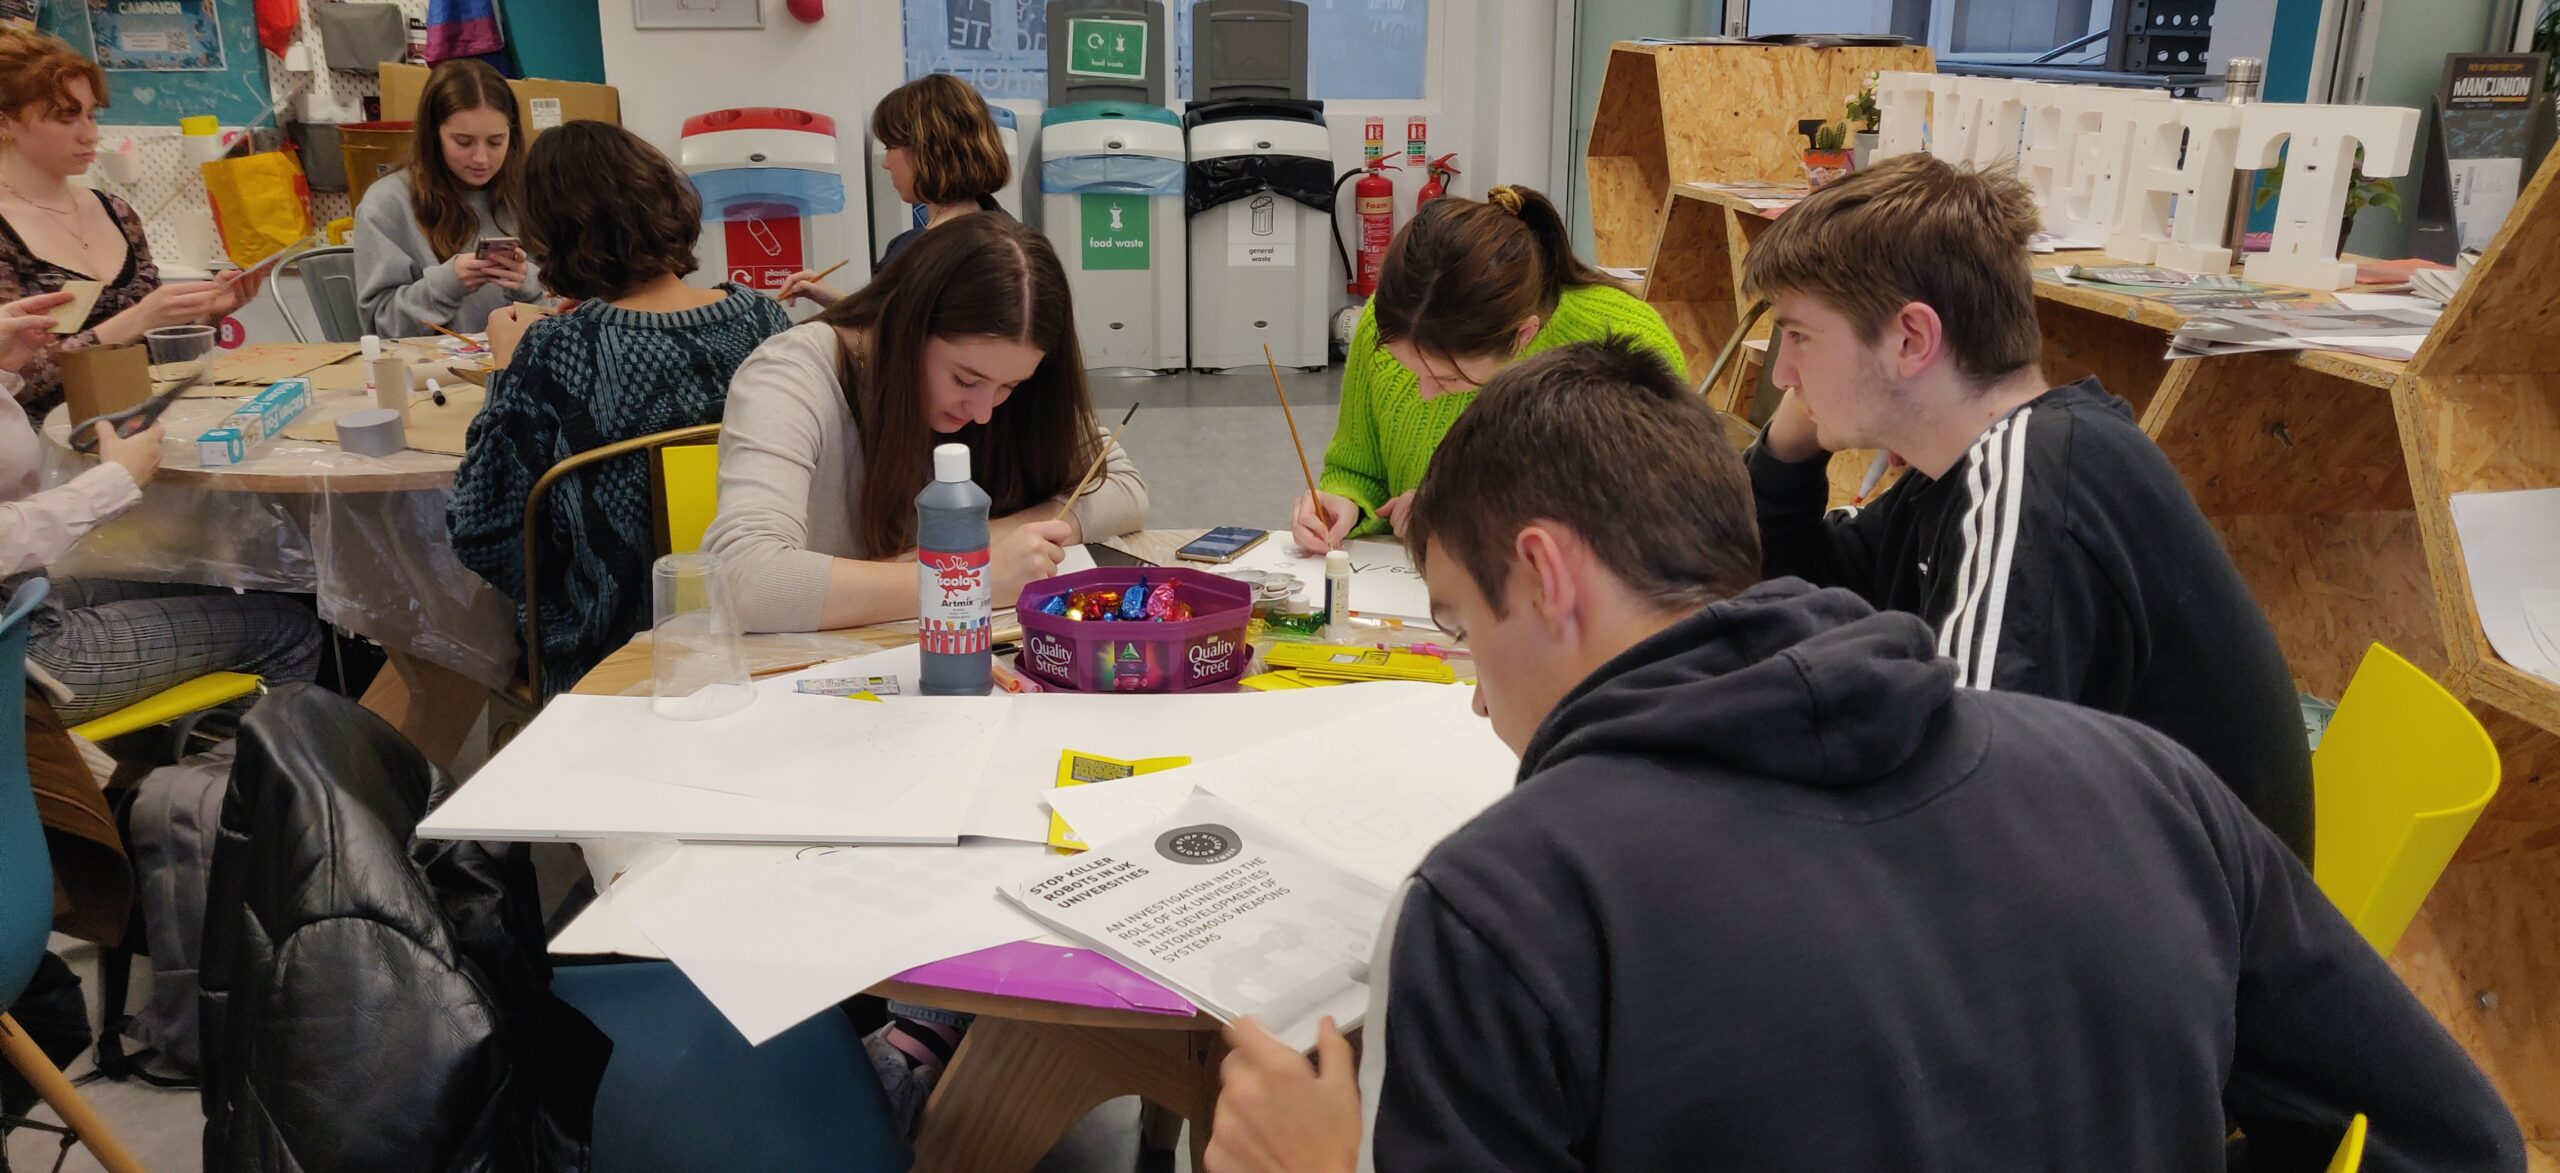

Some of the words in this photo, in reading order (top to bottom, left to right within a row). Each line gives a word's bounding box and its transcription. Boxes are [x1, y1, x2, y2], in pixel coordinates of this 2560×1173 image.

[2453, 76, 2532, 97] MANCUNION
[1366, 202, 1388, 210] Foam
[1090, 237, 1113, 248] food
[1115, 239, 1144, 248] waste
[1249, 247, 1274, 255] general
[939, 574, 971, 587] scola
[941, 598, 974, 607] Artmix
[1030, 636, 1073, 666] Quality
[1188, 640, 1236, 665] Quality
[1036, 656, 1069, 680] Street
[1192, 658, 1230, 680] Street
[1176, 833, 1198, 846] STOP
[1029, 875, 1066, 896] STOP
[1068, 856, 1115, 879] KILLER
[1043, 876, 1099, 902] ROBOTS
[1100, 868, 1114, 881] IN
[1115, 860, 1136, 875] UK
[1057, 867, 1150, 910] UNIVERSITIES
[1105, 920, 1126, 935] AN
[1127, 880, 1214, 926] INVESTIGATION
[1214, 867, 1242, 887] INTO
[1241, 857, 1268, 874] THE
[1118, 922, 1152, 941] ROLE
[1153, 915, 1173, 928] OF
[1171, 904, 1191, 920] UK
[1187, 868, 1270, 910] UNIVERSITIES
[1132, 935, 1151, 949] IN
[1152, 922, 1178, 941] THE
[1177, 885, 1262, 929] DEVELOPMENT
[1262, 876, 1279, 892] OF
[1149, 912, 1235, 957] AUTONOMOUS
[1233, 885, 1292, 916] WEAPONS
[1162, 931, 1223, 965] SYSTEMS
